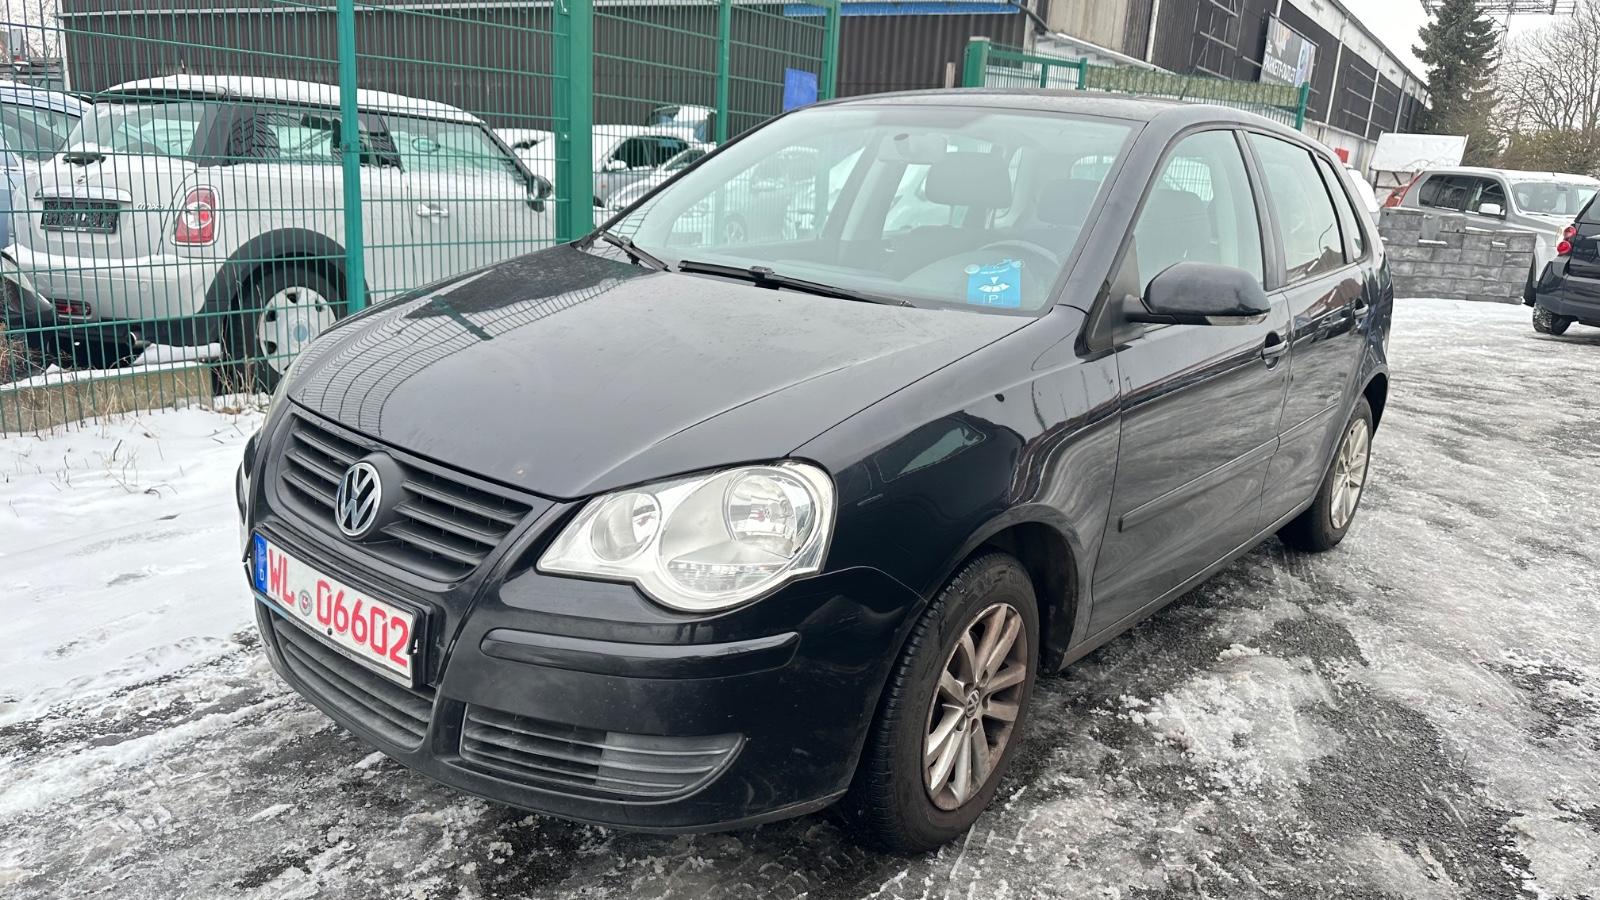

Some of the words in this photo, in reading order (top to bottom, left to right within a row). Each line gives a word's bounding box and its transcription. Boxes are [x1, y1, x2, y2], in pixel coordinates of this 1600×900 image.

[988, 294, 999, 304] P
[336, 463, 382, 536] VW
[268, 548, 296, 606] WL
[316, 578, 409, 669] 06602
